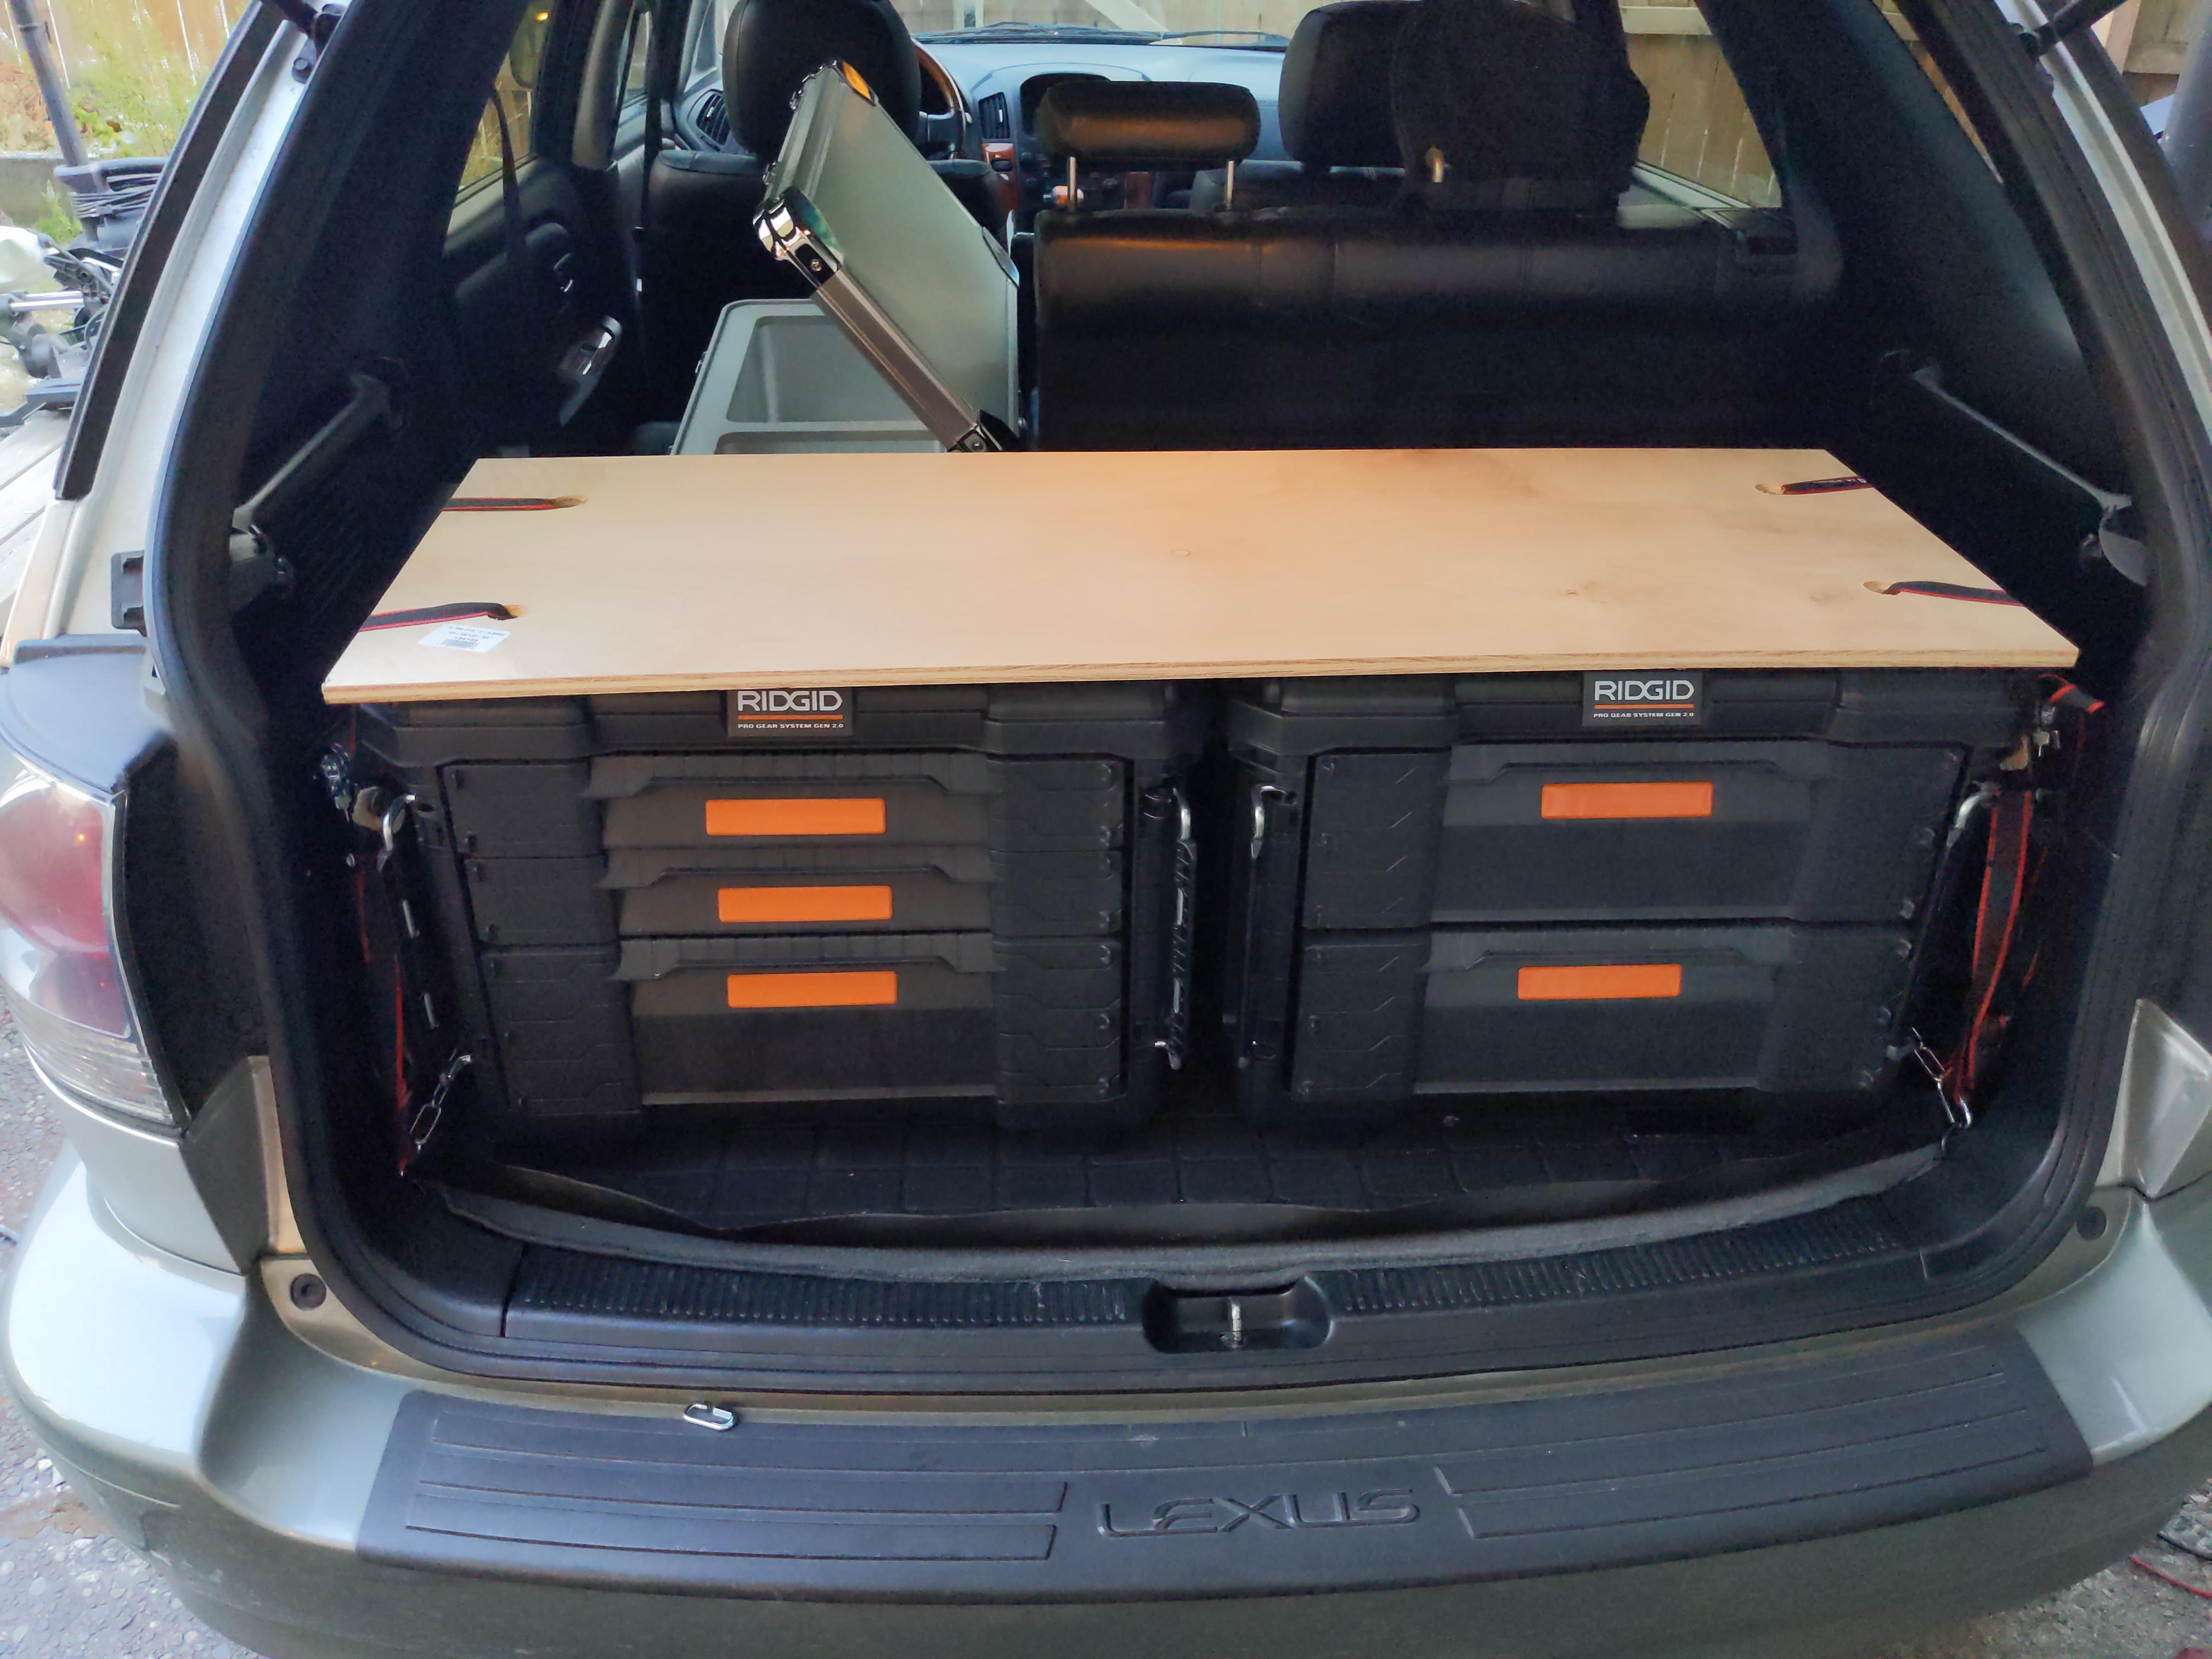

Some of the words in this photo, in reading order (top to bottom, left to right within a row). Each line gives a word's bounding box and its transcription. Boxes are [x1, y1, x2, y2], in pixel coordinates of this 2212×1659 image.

[737, 690, 843, 712] RIDGID
[1594, 680, 1694, 701] RIDGID
[1097, 1487, 1420, 1537] LEXUS
